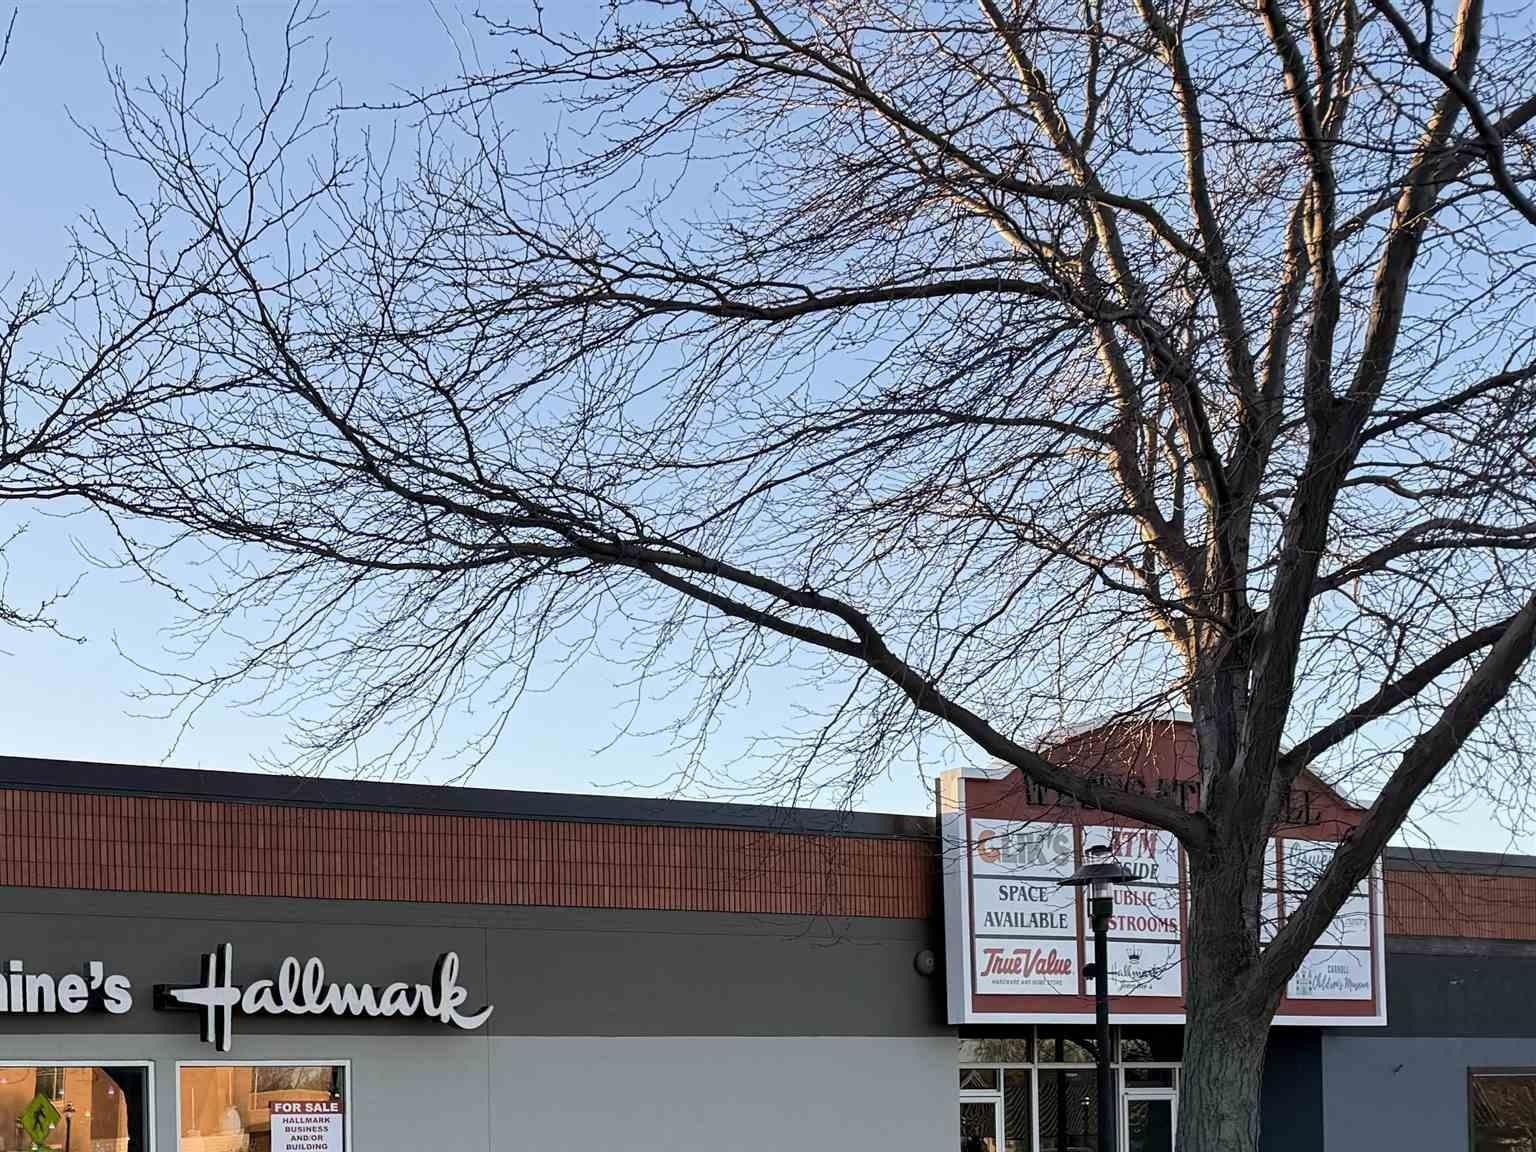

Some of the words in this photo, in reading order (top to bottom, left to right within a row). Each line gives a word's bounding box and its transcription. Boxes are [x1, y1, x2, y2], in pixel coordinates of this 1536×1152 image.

[999, 885, 1049, 902] SPACE
[1105, 888, 1157, 908] UBLIC
[984, 911, 1068, 929] AVAILABLE
[1089, 914, 1177, 933] STROOMS
[981, 948, 1022, 976] True
[1013, 948, 1072, 978] Value
[171, 943, 494, 1052] Hallmark
[275, 1102, 301, 1112] FOR
[305, 1102, 338, 1112] SALE
[286, 1143, 328, 1151] BUILDING
